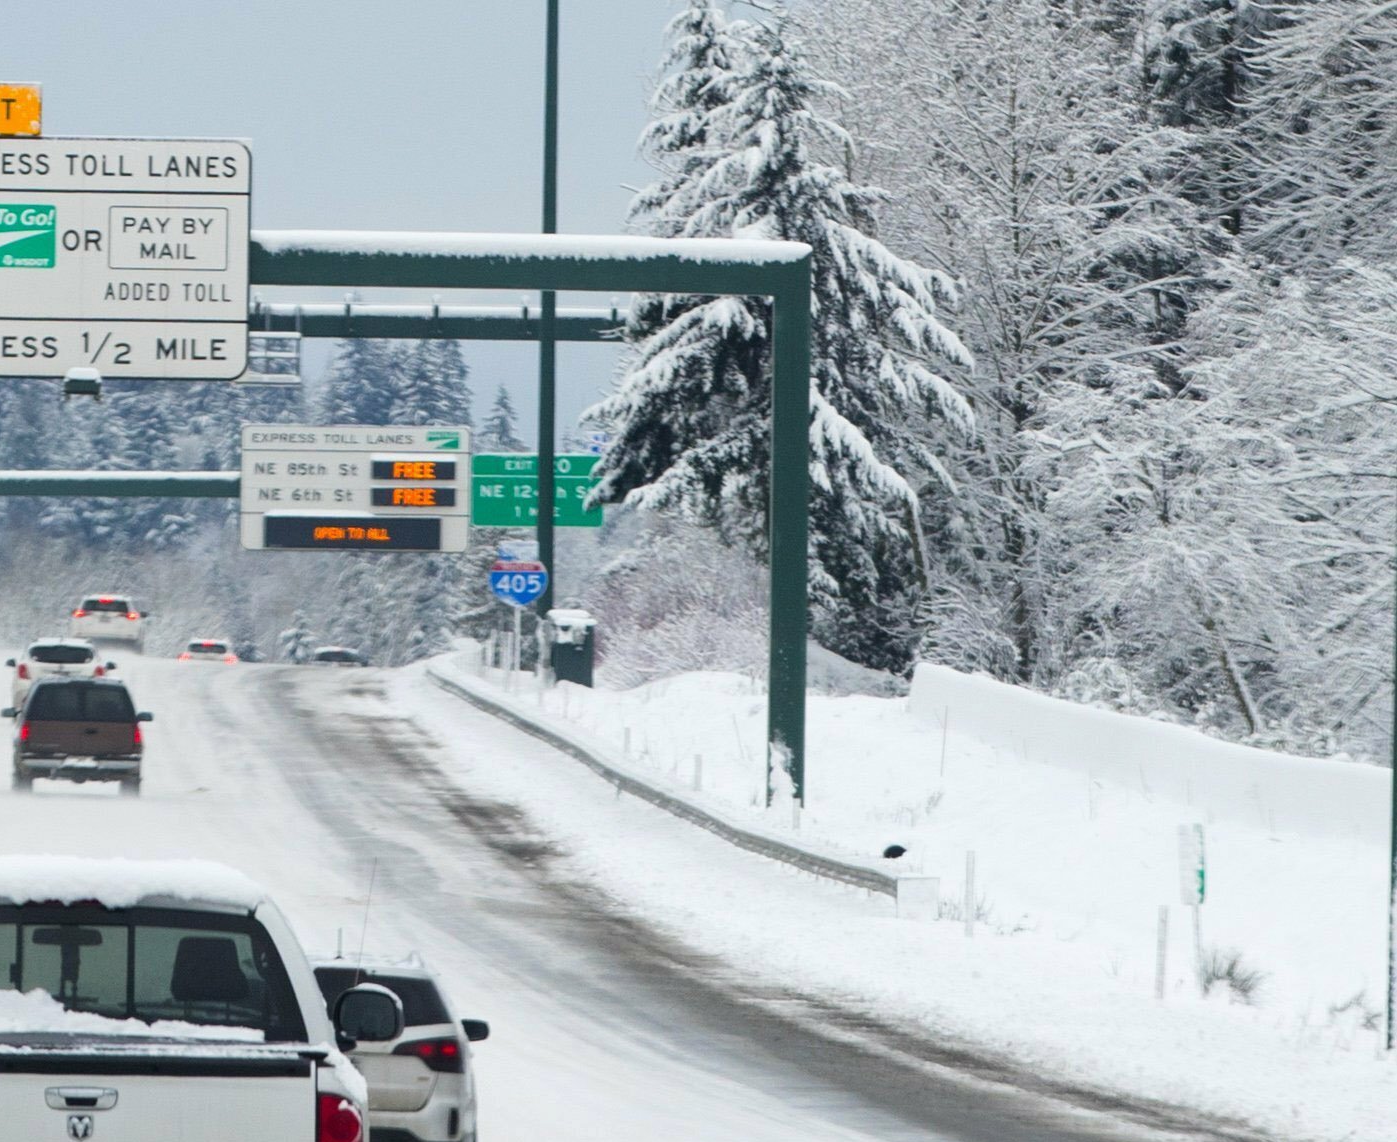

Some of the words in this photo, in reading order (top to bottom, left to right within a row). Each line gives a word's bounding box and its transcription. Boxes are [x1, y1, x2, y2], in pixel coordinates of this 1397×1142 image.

[66, 154, 133, 177] TOLL
[148, 155, 238, 178] LANES
[20, 208, 55, 226] Go!
[122, 217, 171, 234] PAY
[183, 217, 214, 235] BY
[62, 230, 102, 252] OR
[140, 243, 197, 260] MAIL
[104, 282, 171, 302] ADDED
[182, 283, 232, 303] TOLL
[155, 337, 227, 361] MILE
[251, 432, 316, 445] EXPRESS
[324, 433, 359, 445] TOLL
[366, 433, 414, 446] LANES
[254, 462, 277, 476] NE
[286, 462, 327, 476] 85th
[338, 463, 359, 477] St
[392, 461, 437, 479] FREE
[504, 460, 534, 471] EXIT
[259, 488, 282, 501] NE
[291, 488, 322, 502] 6th
[334, 488, 354, 502] St
[392, 487, 437, 505] FREE
[479, 484, 505, 498] NE
[313, 526, 343, 540] OPEN
[346, 527, 365, 540] TO
[366, 527, 391, 541] ALL
[496, 574, 542, 594] 405
